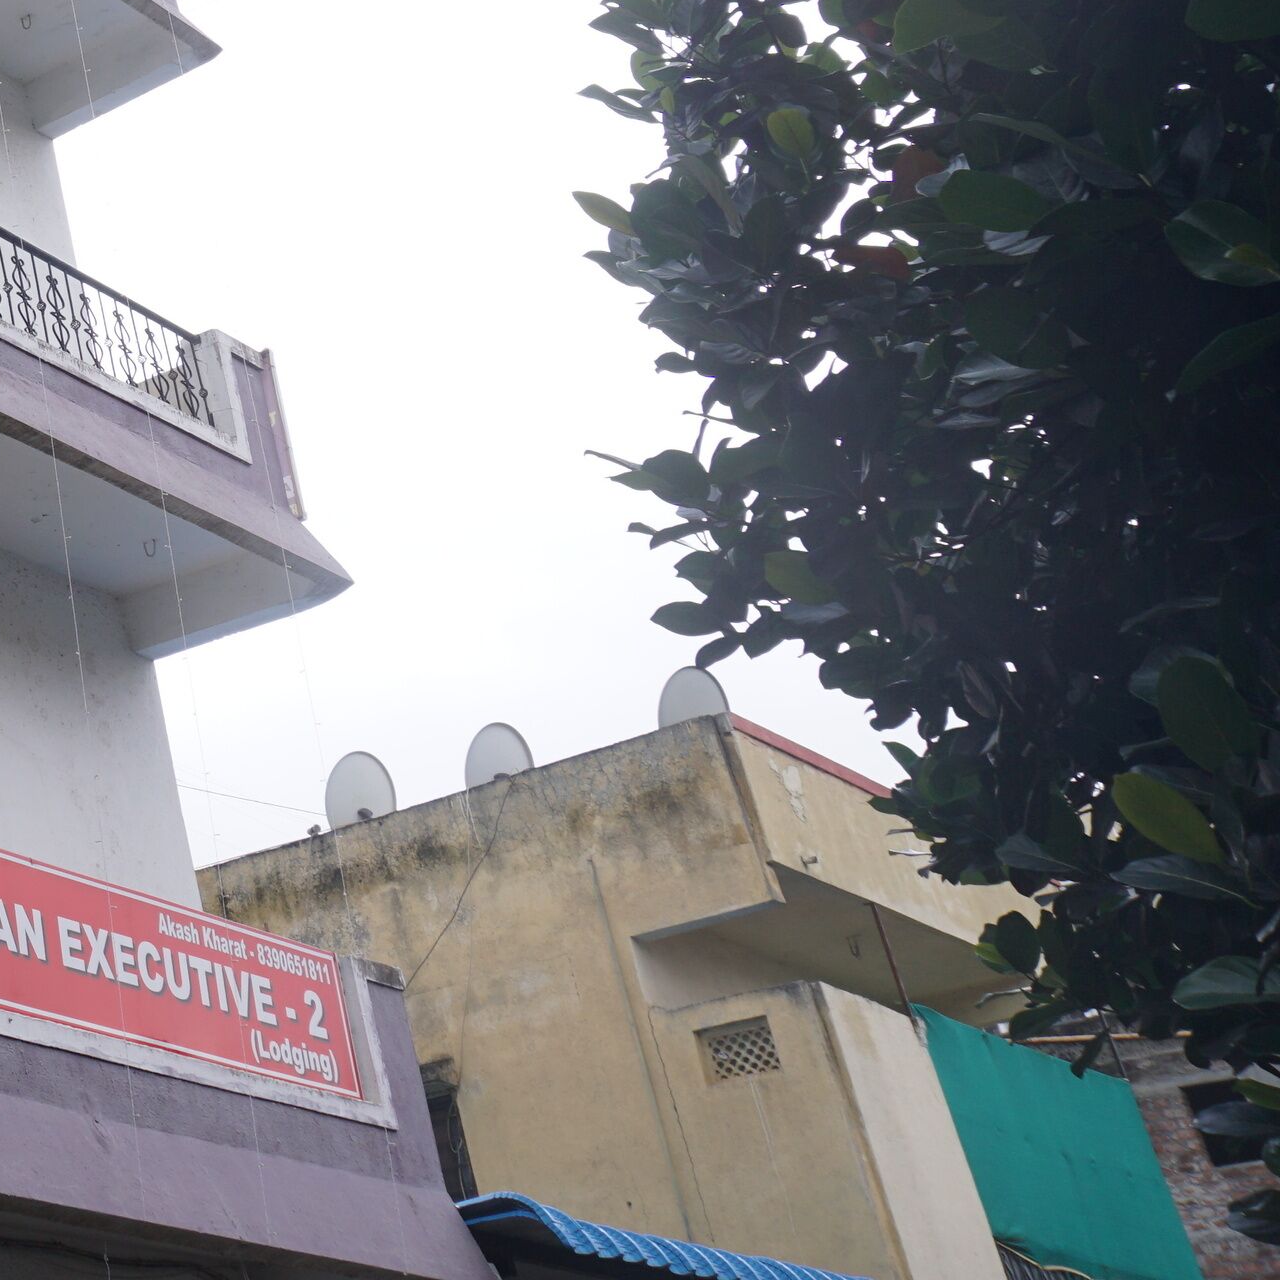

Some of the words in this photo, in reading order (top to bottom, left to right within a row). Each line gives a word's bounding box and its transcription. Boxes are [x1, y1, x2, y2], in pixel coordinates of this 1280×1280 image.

[57, 915, 278, 1027] EXECUTIVE
[304, 990, 330, 1040] 2
[158, 913, 200, 945] Akash
[202, 926, 248, 960] Kharat
[256, 943, 331, 985] 8390651811
[250, 1030, 339, 1083] (Lodging)
